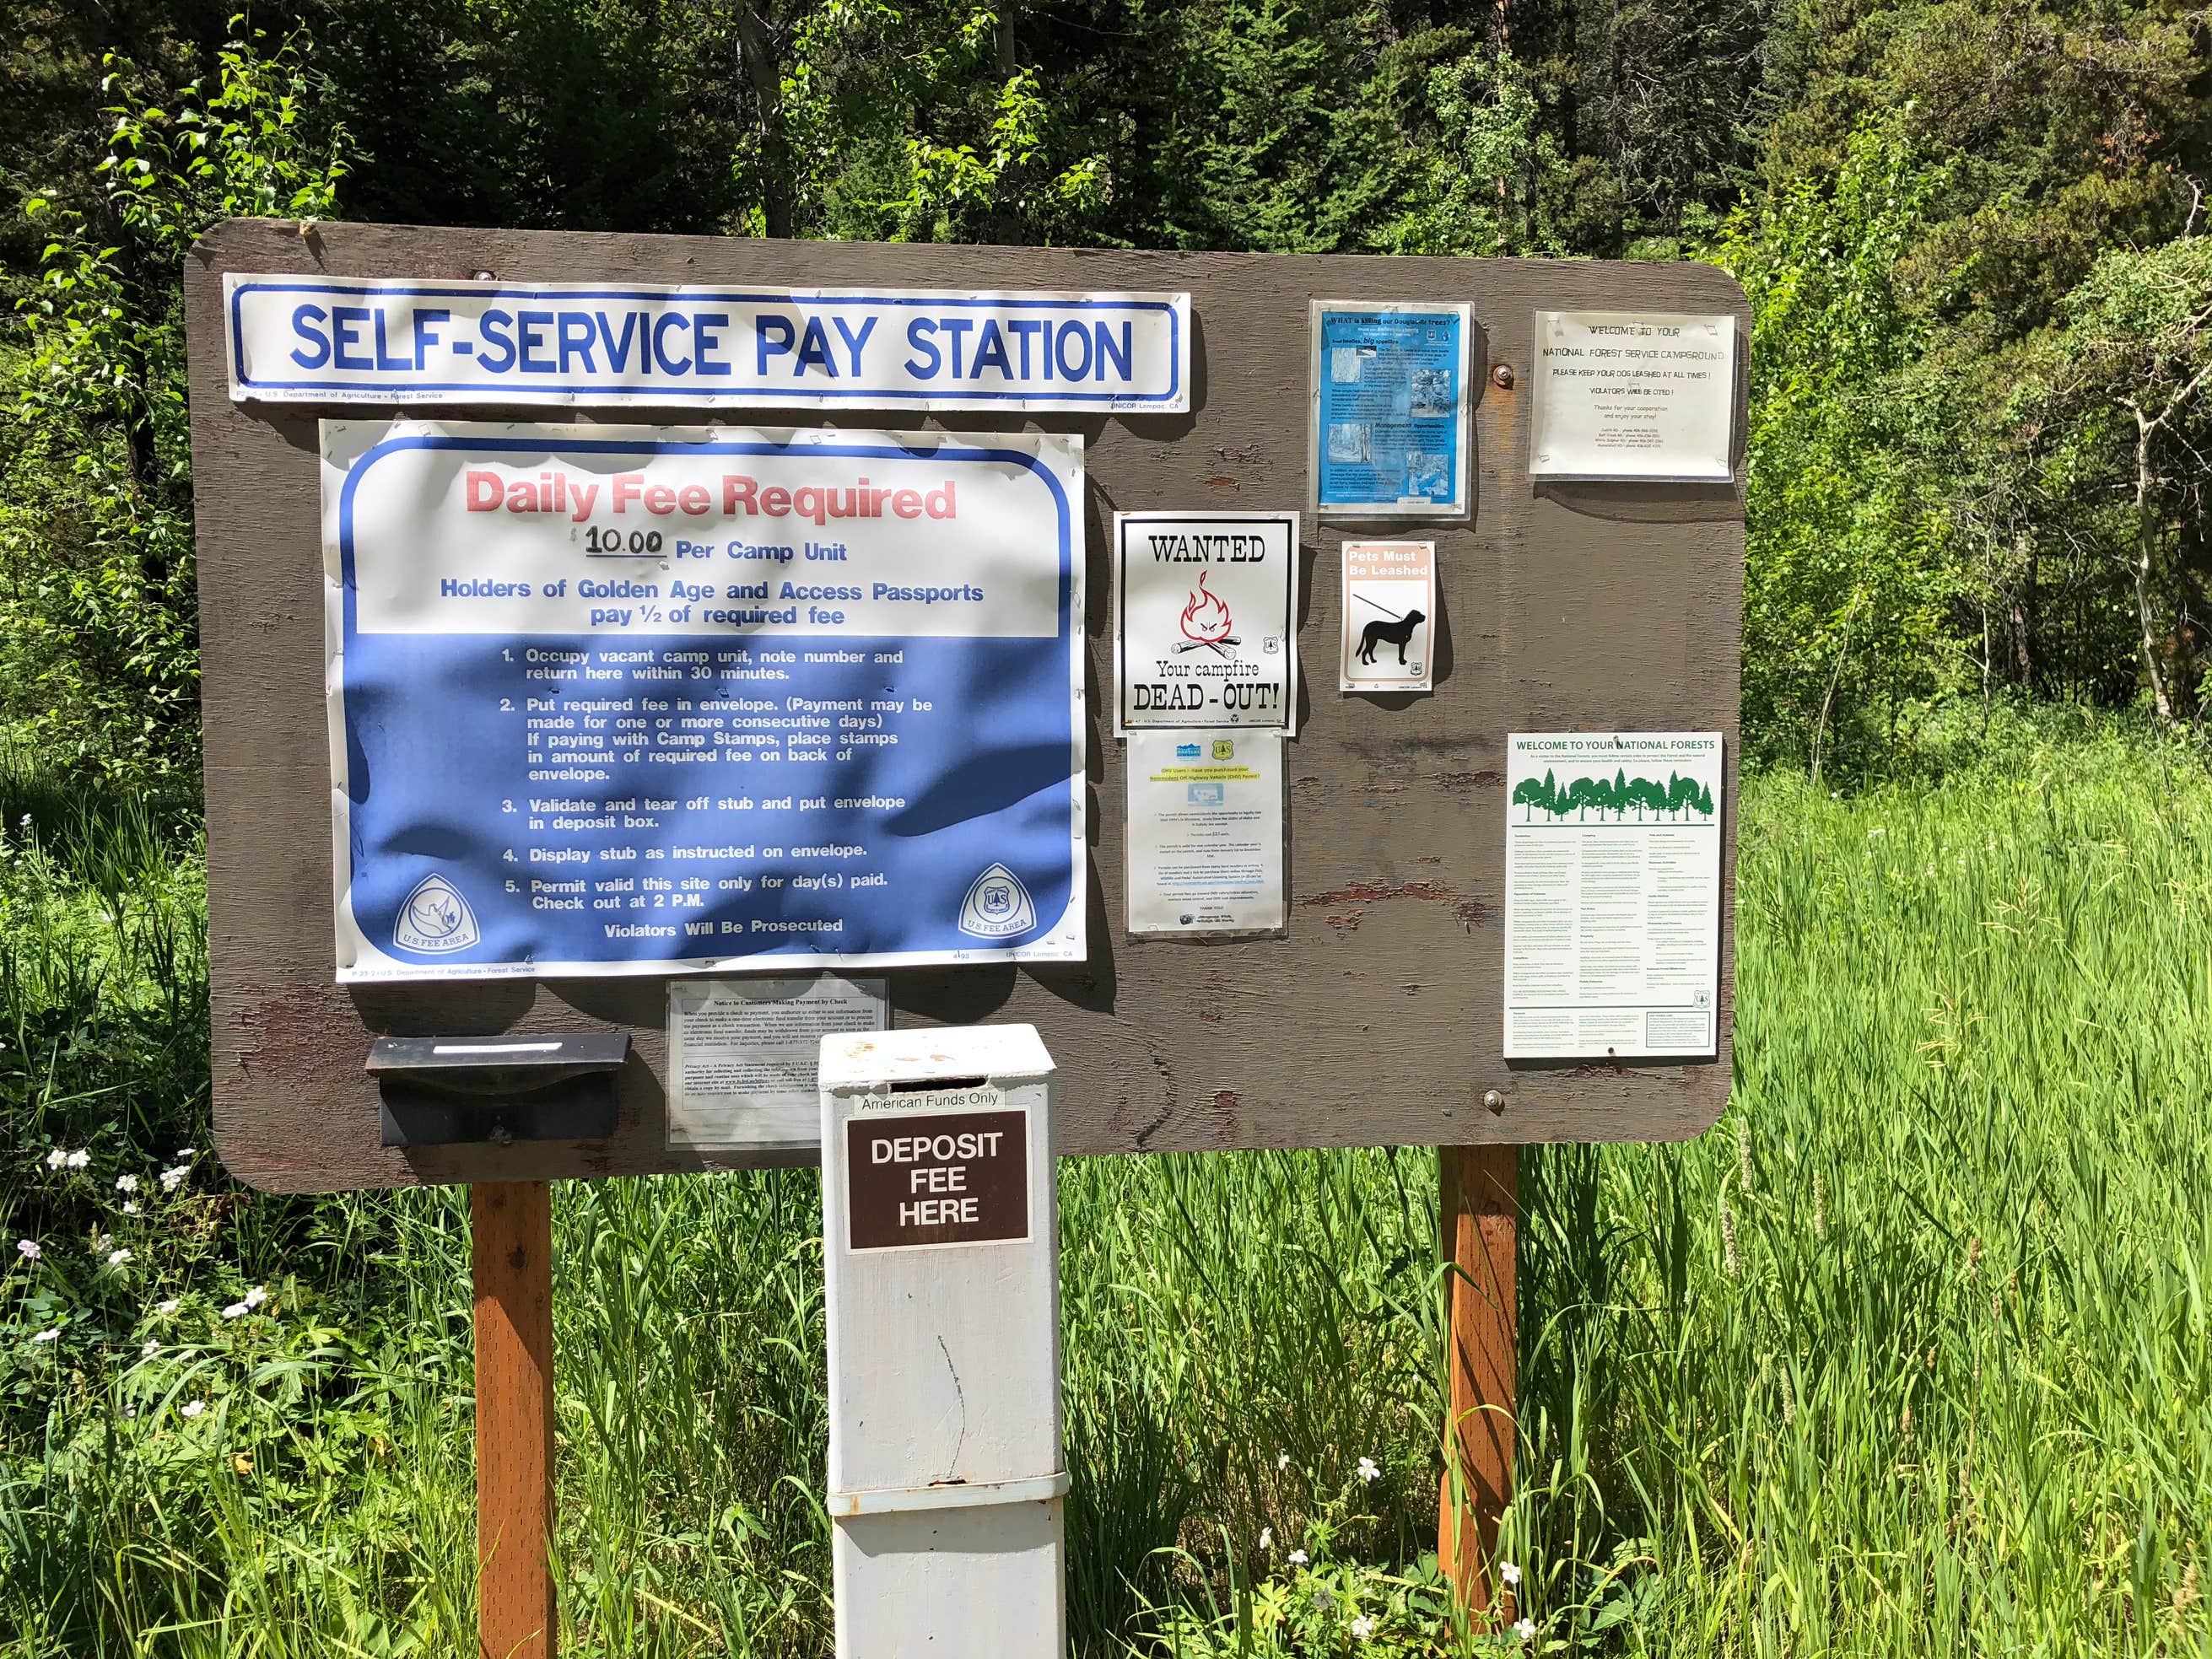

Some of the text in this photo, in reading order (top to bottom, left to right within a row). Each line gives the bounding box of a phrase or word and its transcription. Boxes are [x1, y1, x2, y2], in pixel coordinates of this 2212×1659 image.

[1589, 326, 1680, 337] WELCOME TO YOUR
[290, 304, 1132, 382] SELF-SERVICE PAY STATION
[1543, 347, 1724, 361] NATIONAL FOREST SERVICE CAMPGROUND
[1596, 369, 1615, 378] YOUR
[1632, 370, 1660, 379] LEASHED
[467, 471, 957, 526] Daily Fee Required
[585, 525, 662, 554] 10.00
[1148, 535, 1265, 563] WANTED
[676, 541, 847, 565] Per Camp Unit
[1350, 551, 1416, 562] Pets Must
[1350, 565, 1427, 576] Be Leashed
[440, 579, 984, 605] Holders of Golden Age and Access Passports
[591, 609, 632, 627] pay
[669, 605, 691, 622] of
[704, 605, 796, 628] required
[808, 606, 844, 624] fee
[502, 647, 904, 667] 1. Occupy vacant camp unit, note number and
[526, 665, 790, 681] return here within 30 minutes.
[1156, 660, 1259, 682] Your campfire
[500, 696, 932, 714] 2. Put required fee in envelope. (Payment may be
[1517, 741, 1714, 750] WELCOME TO YOUR NATIONAL FORESTS
[502, 794, 905, 813] 3. Validate and tear off stub and put envelope
[529, 815, 659, 832] in deposit box.
[503, 843, 867, 864] 4. Display stub as instructed on envelope.
[505, 873, 887, 892] 5. Permit valid this site only for day(s) paid.
[532, 894, 704, 909] Check out at 2 P.M.
[605, 918, 843, 937] Violators Will Be Prosecuted
[983, 924, 1001, 933] FEE
[1003, 920, 1027, 932] AREA
[422, 939, 440, 947] FEE
[442, 934, 469, 945] AREA
[772, 999, 794, 1007] Making
[796, 999, 821, 1007] Payment
[822, 999, 828, 1007] by
[862, 1092, 998, 1110] American Funds Only
[871, 1132, 1003, 1164] DEPOSIT
[911, 1166, 967, 1193] FEE
[899, 1198, 979, 1226] HERE
